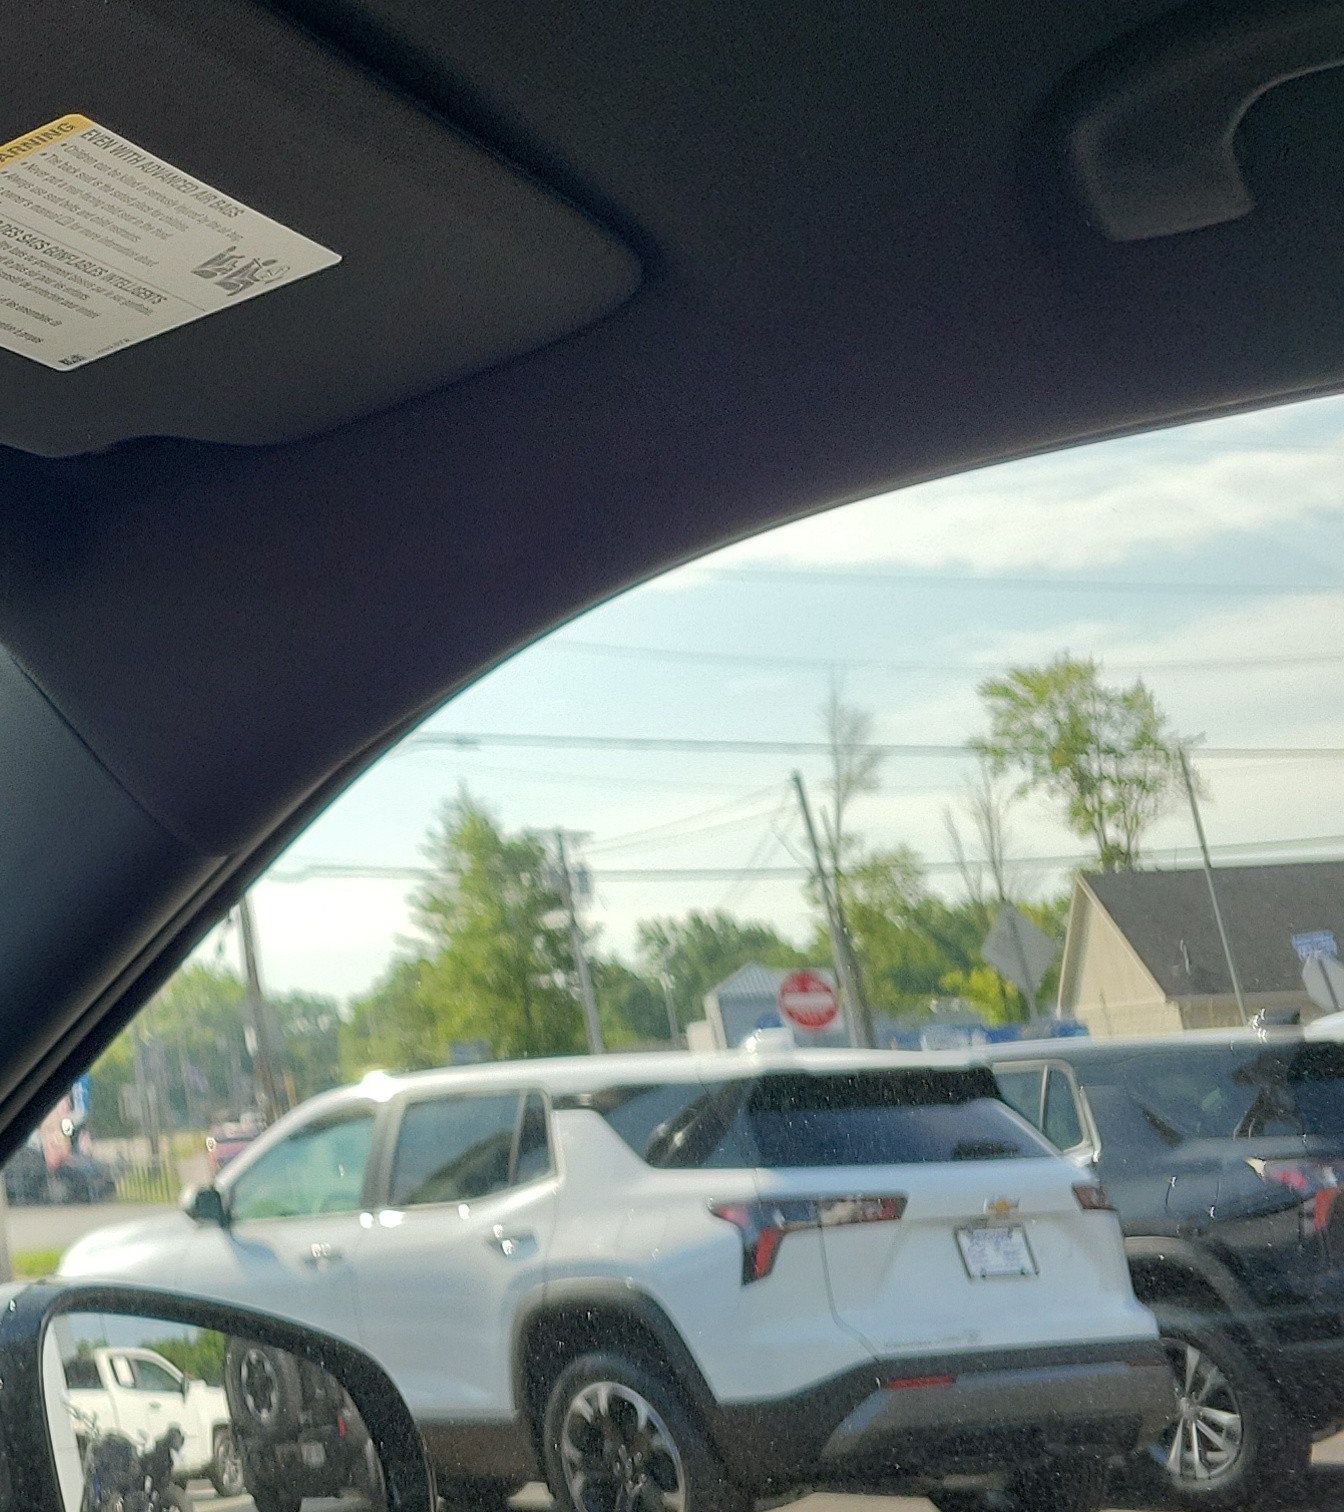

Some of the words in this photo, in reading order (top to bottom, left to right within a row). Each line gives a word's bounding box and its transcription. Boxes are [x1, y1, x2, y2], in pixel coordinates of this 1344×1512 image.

[77, 128, 119, 149] EVEN
[106, 144, 147, 164] WITH
[134, 159, 202, 194] ADVANCED
[189, 188, 220, 203] AIR
[206, 198, 247, 218] BAGS
[13, 232, 53, 251] SACS
[40, 245, 110, 277] GONFLABLES
[98, 272, 169, 304] INTELLIGENTS
